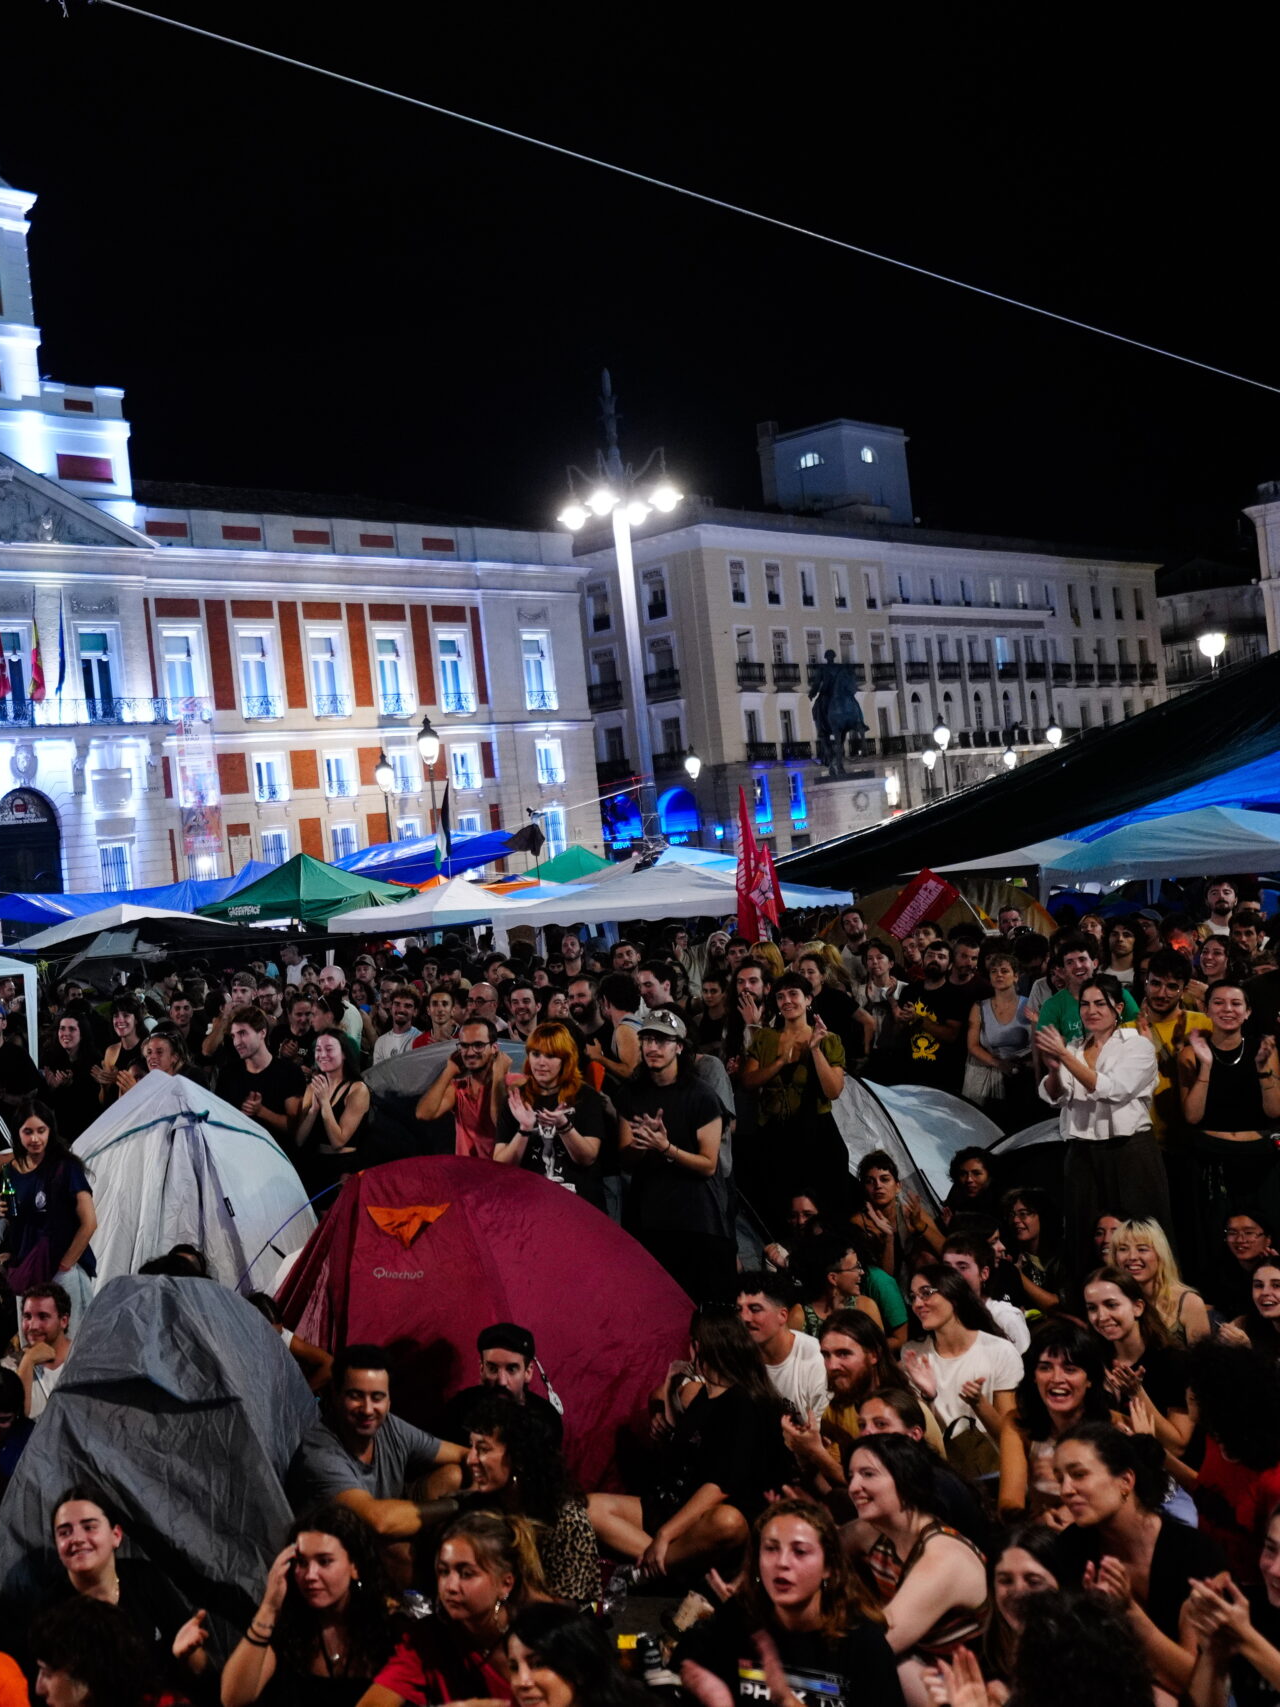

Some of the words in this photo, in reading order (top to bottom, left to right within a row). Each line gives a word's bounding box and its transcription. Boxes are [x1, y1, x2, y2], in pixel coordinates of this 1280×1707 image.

[612, 841, 631, 850] BBVA
[669, 835, 689, 845] BBVA
[228, 904, 261, 916] GREENPEACE
[372, 1266, 425, 1280] Quechua
